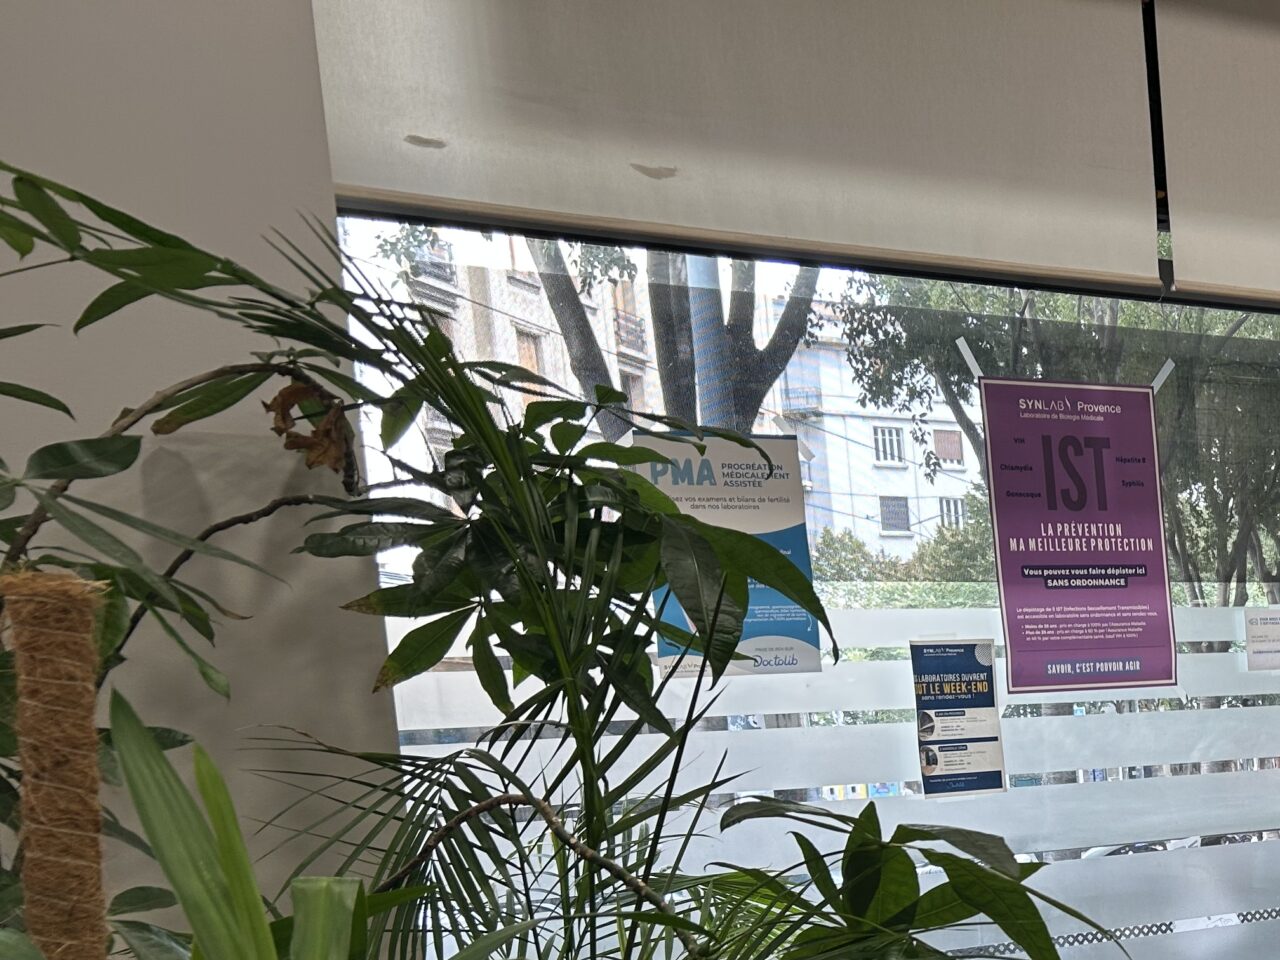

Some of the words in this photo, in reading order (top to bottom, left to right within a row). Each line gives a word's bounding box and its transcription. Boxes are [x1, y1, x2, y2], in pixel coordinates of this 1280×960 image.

[1018, 398, 1065, 411] SYNLAB
[1077, 401, 1122, 414] Provence
[650, 457, 717, 486] PMA
[1041, 434, 1111, 512] IST
[723, 480, 762, 488] ASSISTÉE
[767, 495, 790, 503] fertilité
[1040, 522, 1054, 537] LA
[1057, 520, 1122, 537] PRÉVENTION
[1009, 537, 1025, 551] MA
[1028, 537, 1087, 552] MEILLEURE
[1090, 538, 1154, 551] PROTECTION
[1023, 567, 1042, 576] Vous
[1043, 568, 1070, 577] pouvez
[1089, 567, 1106, 575] faire
[1107, 566, 1136, 576] dépister
[1136, 566, 1146, 574] ici
[1047, 578, 1069, 587] SANS
[1070, 578, 1126, 587] ORDONNANCE
[753, 654, 799, 668] Doctolib
[1047, 663, 1075, 675] SAVOIR,
[1075, 662, 1094, 673] C'EST
[1096, 661, 1124, 672] POUVOIR
[1125, 660, 1141, 671] AGIR
[918, 673, 961, 682] LABORATOIRES
[961, 672, 988, 682] OUVRENT
[929, 682, 941, 695] LE
[943, 681, 988, 694] WEEK-END
